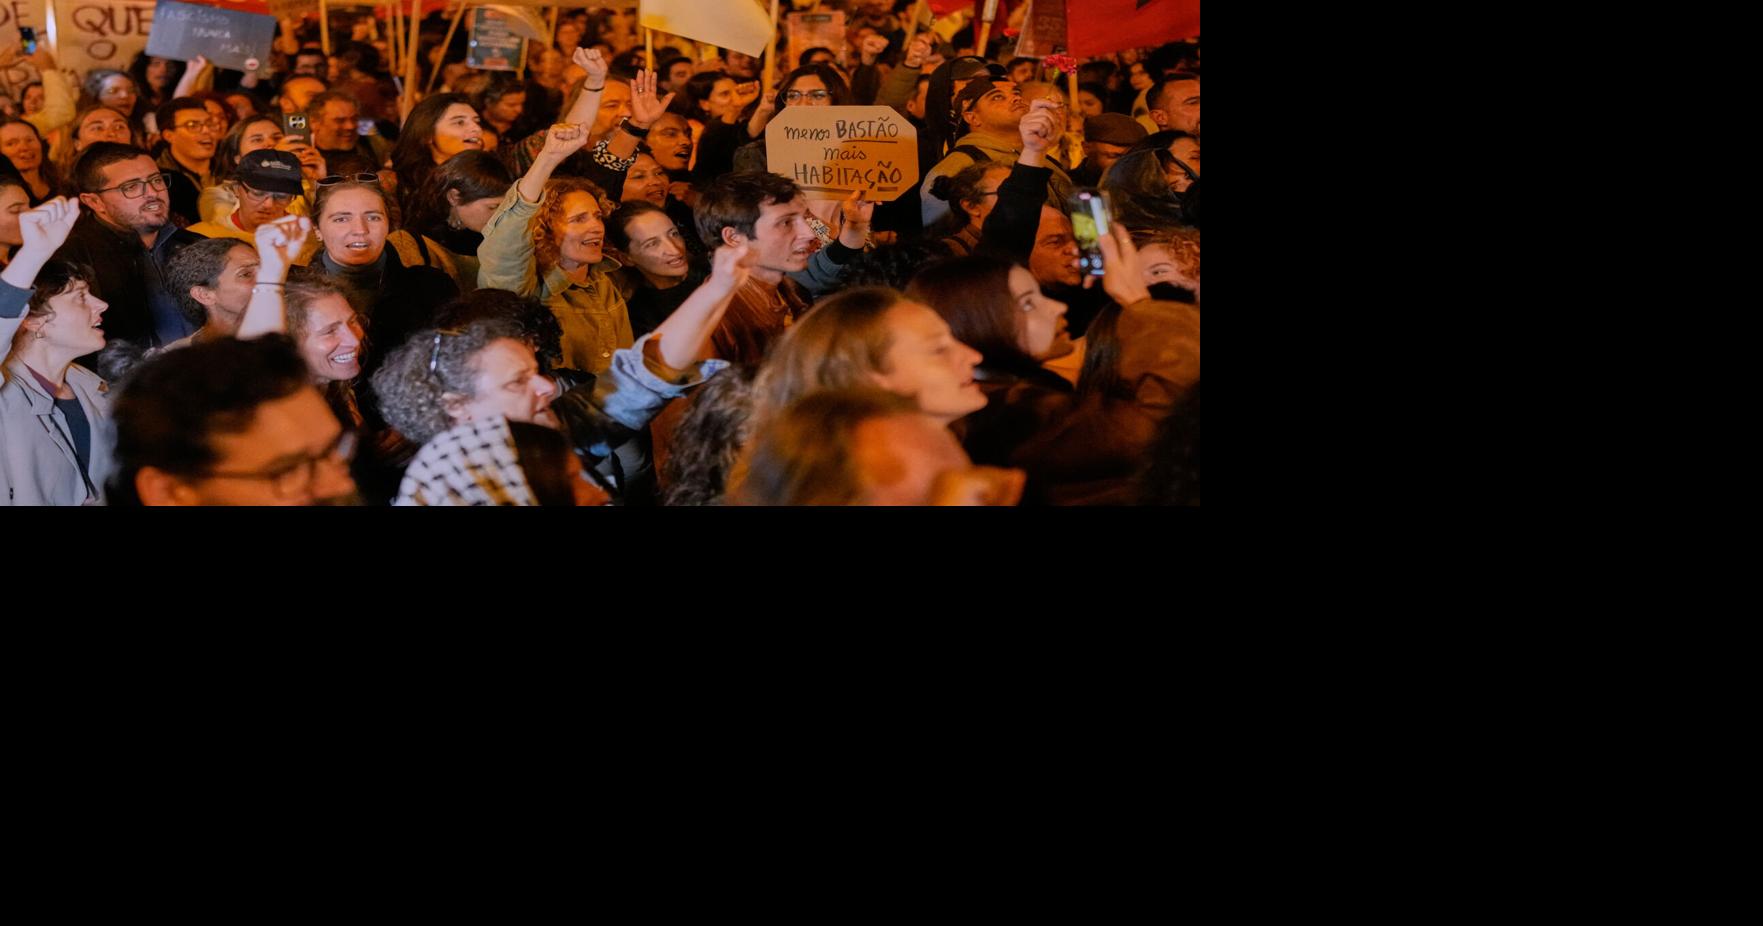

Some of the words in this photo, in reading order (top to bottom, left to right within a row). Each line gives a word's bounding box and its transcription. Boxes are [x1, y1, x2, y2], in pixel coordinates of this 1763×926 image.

[72, 5, 155, 36] QUE
[86, 39, 117, 60] O
[784, 126, 831, 141] menos
[836, 116, 899, 139] BASTÃO
[824, 146, 867, 161] mais
